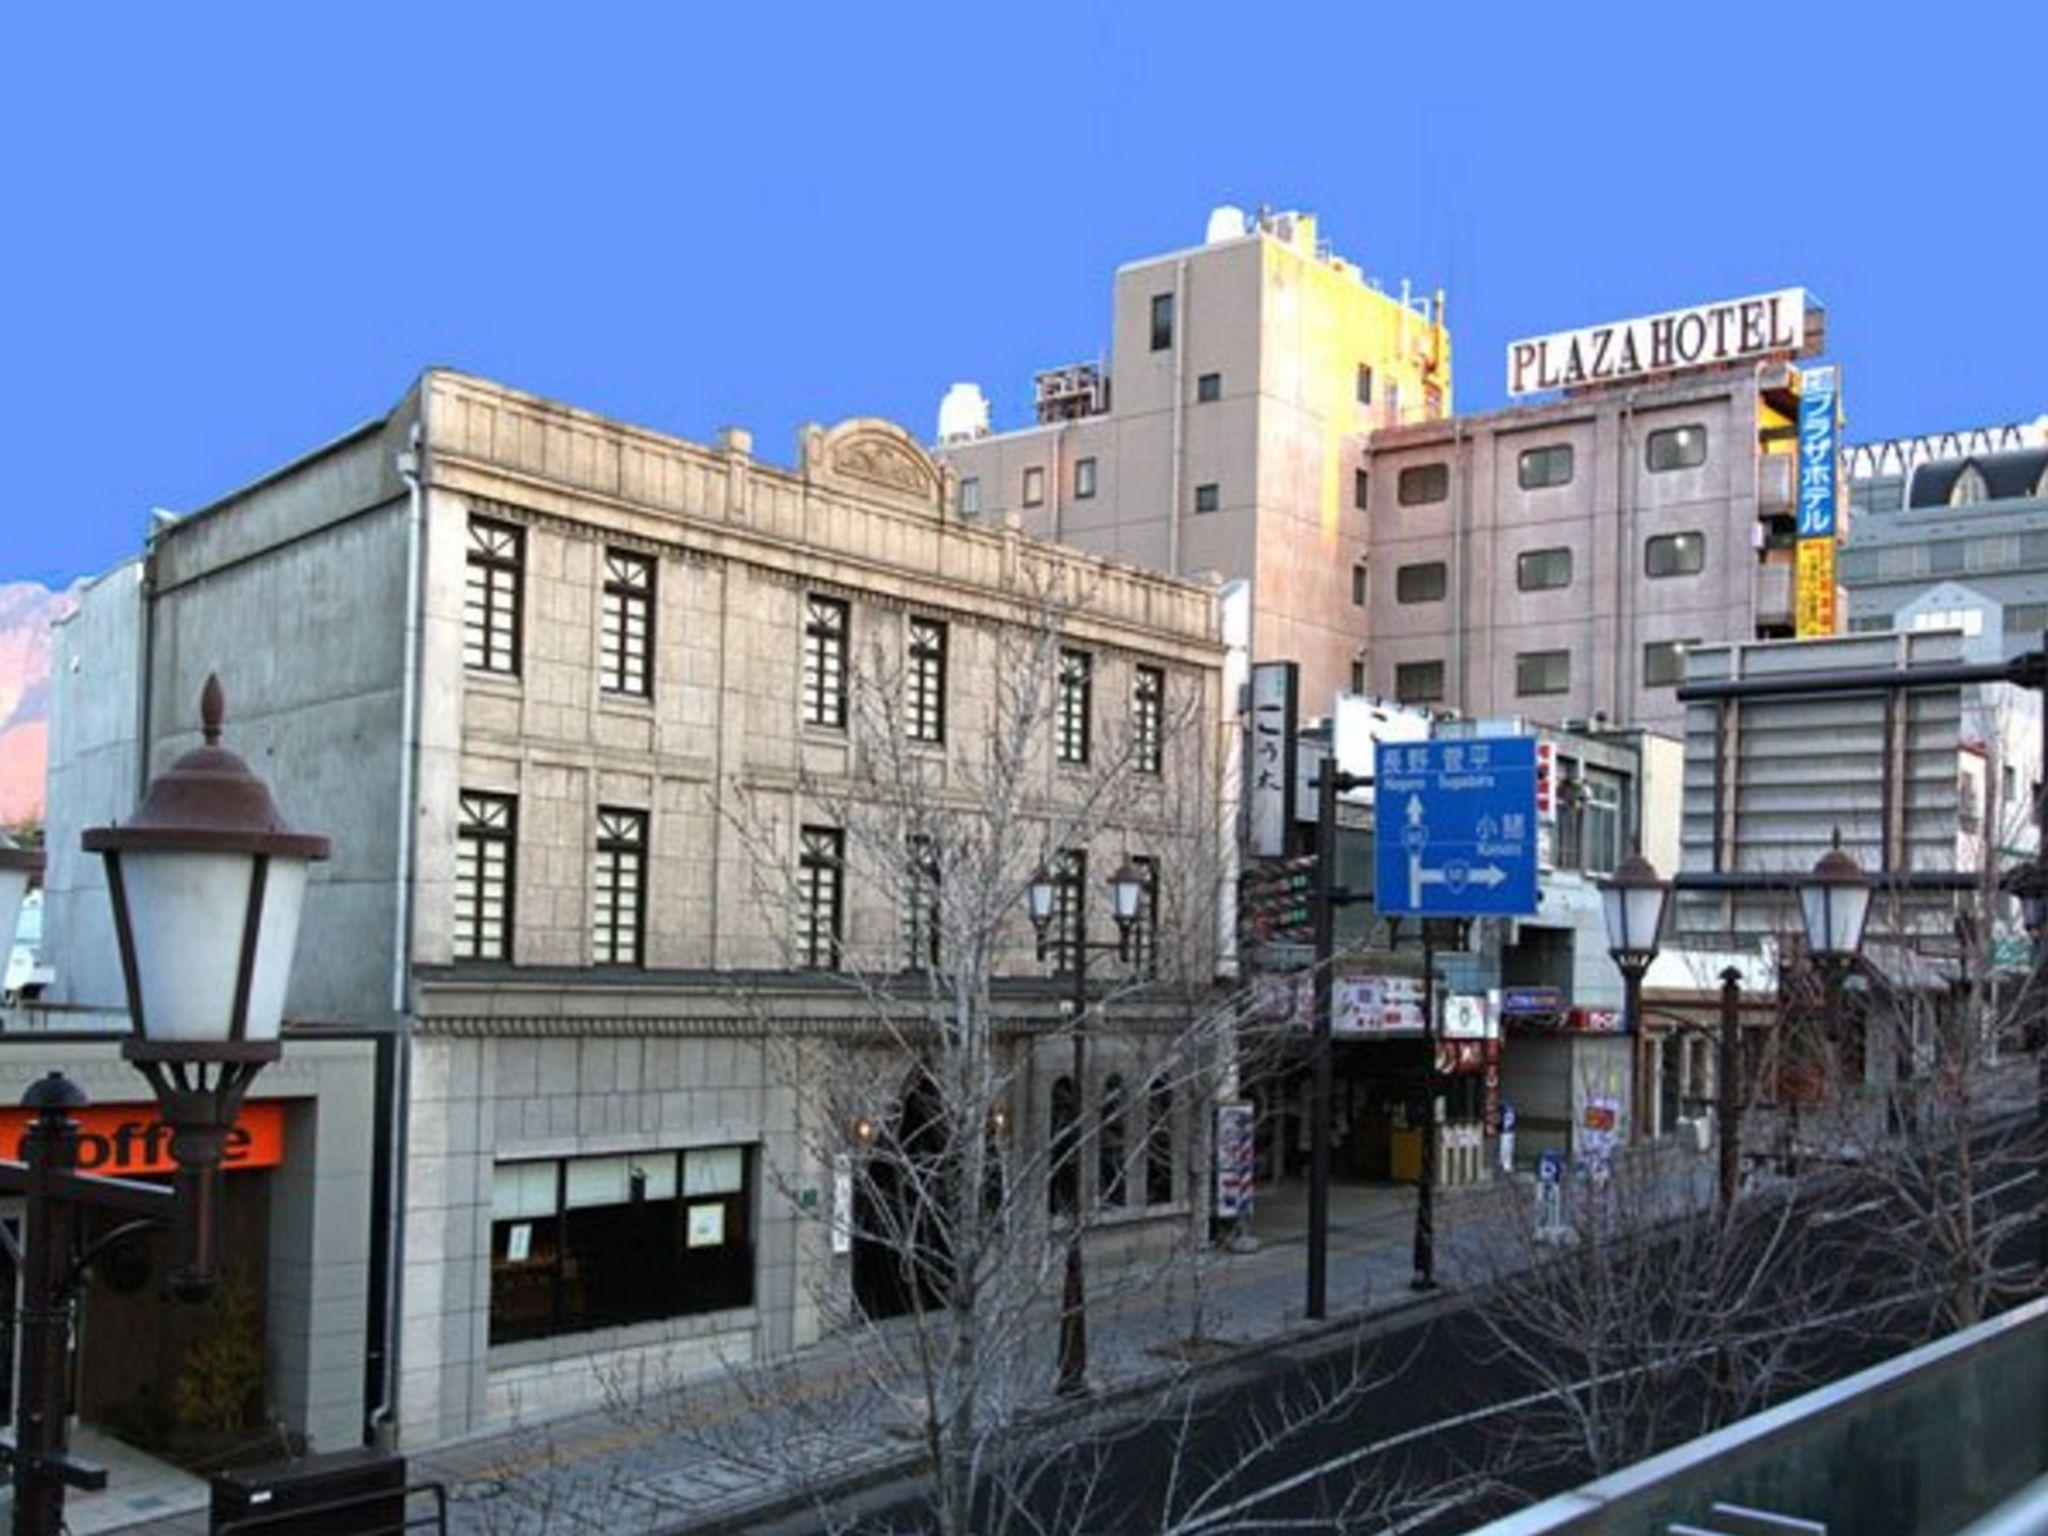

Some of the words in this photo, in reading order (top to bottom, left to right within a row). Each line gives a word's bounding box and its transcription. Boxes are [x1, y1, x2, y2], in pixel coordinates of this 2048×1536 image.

[1513, 325, 1642, 393] PLAZA
[1650, 296, 1795, 368] HOTEL
[16, 1121, 252, 1169] offe
